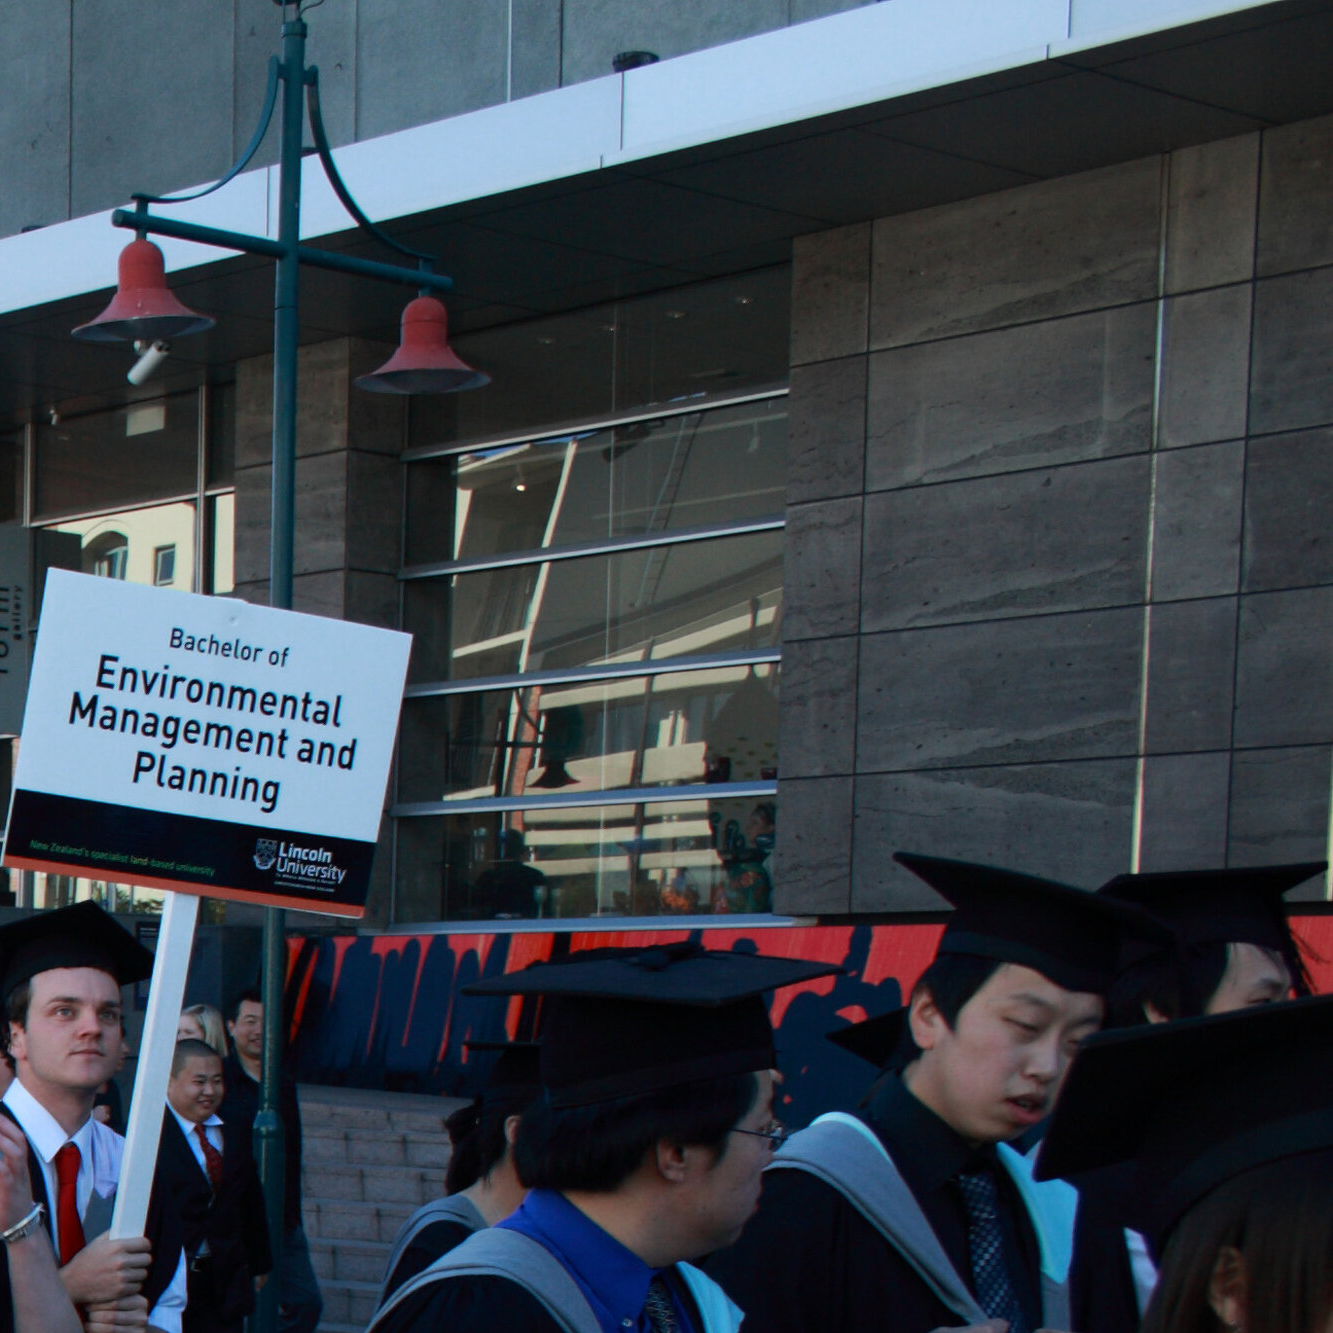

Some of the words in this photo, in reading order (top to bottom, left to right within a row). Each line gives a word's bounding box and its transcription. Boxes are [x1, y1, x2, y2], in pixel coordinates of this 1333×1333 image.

[169, 627, 264, 662] Bachelor
[268, 647, 290, 668] of
[95, 654, 343, 728] Environmental
[69, 691, 289, 759] Management
[297, 738, 357, 771] and
[132, 750, 281, 814] Planning
[276, 857, 348, 884] University
[278, 841, 332, 864] Lincoln
